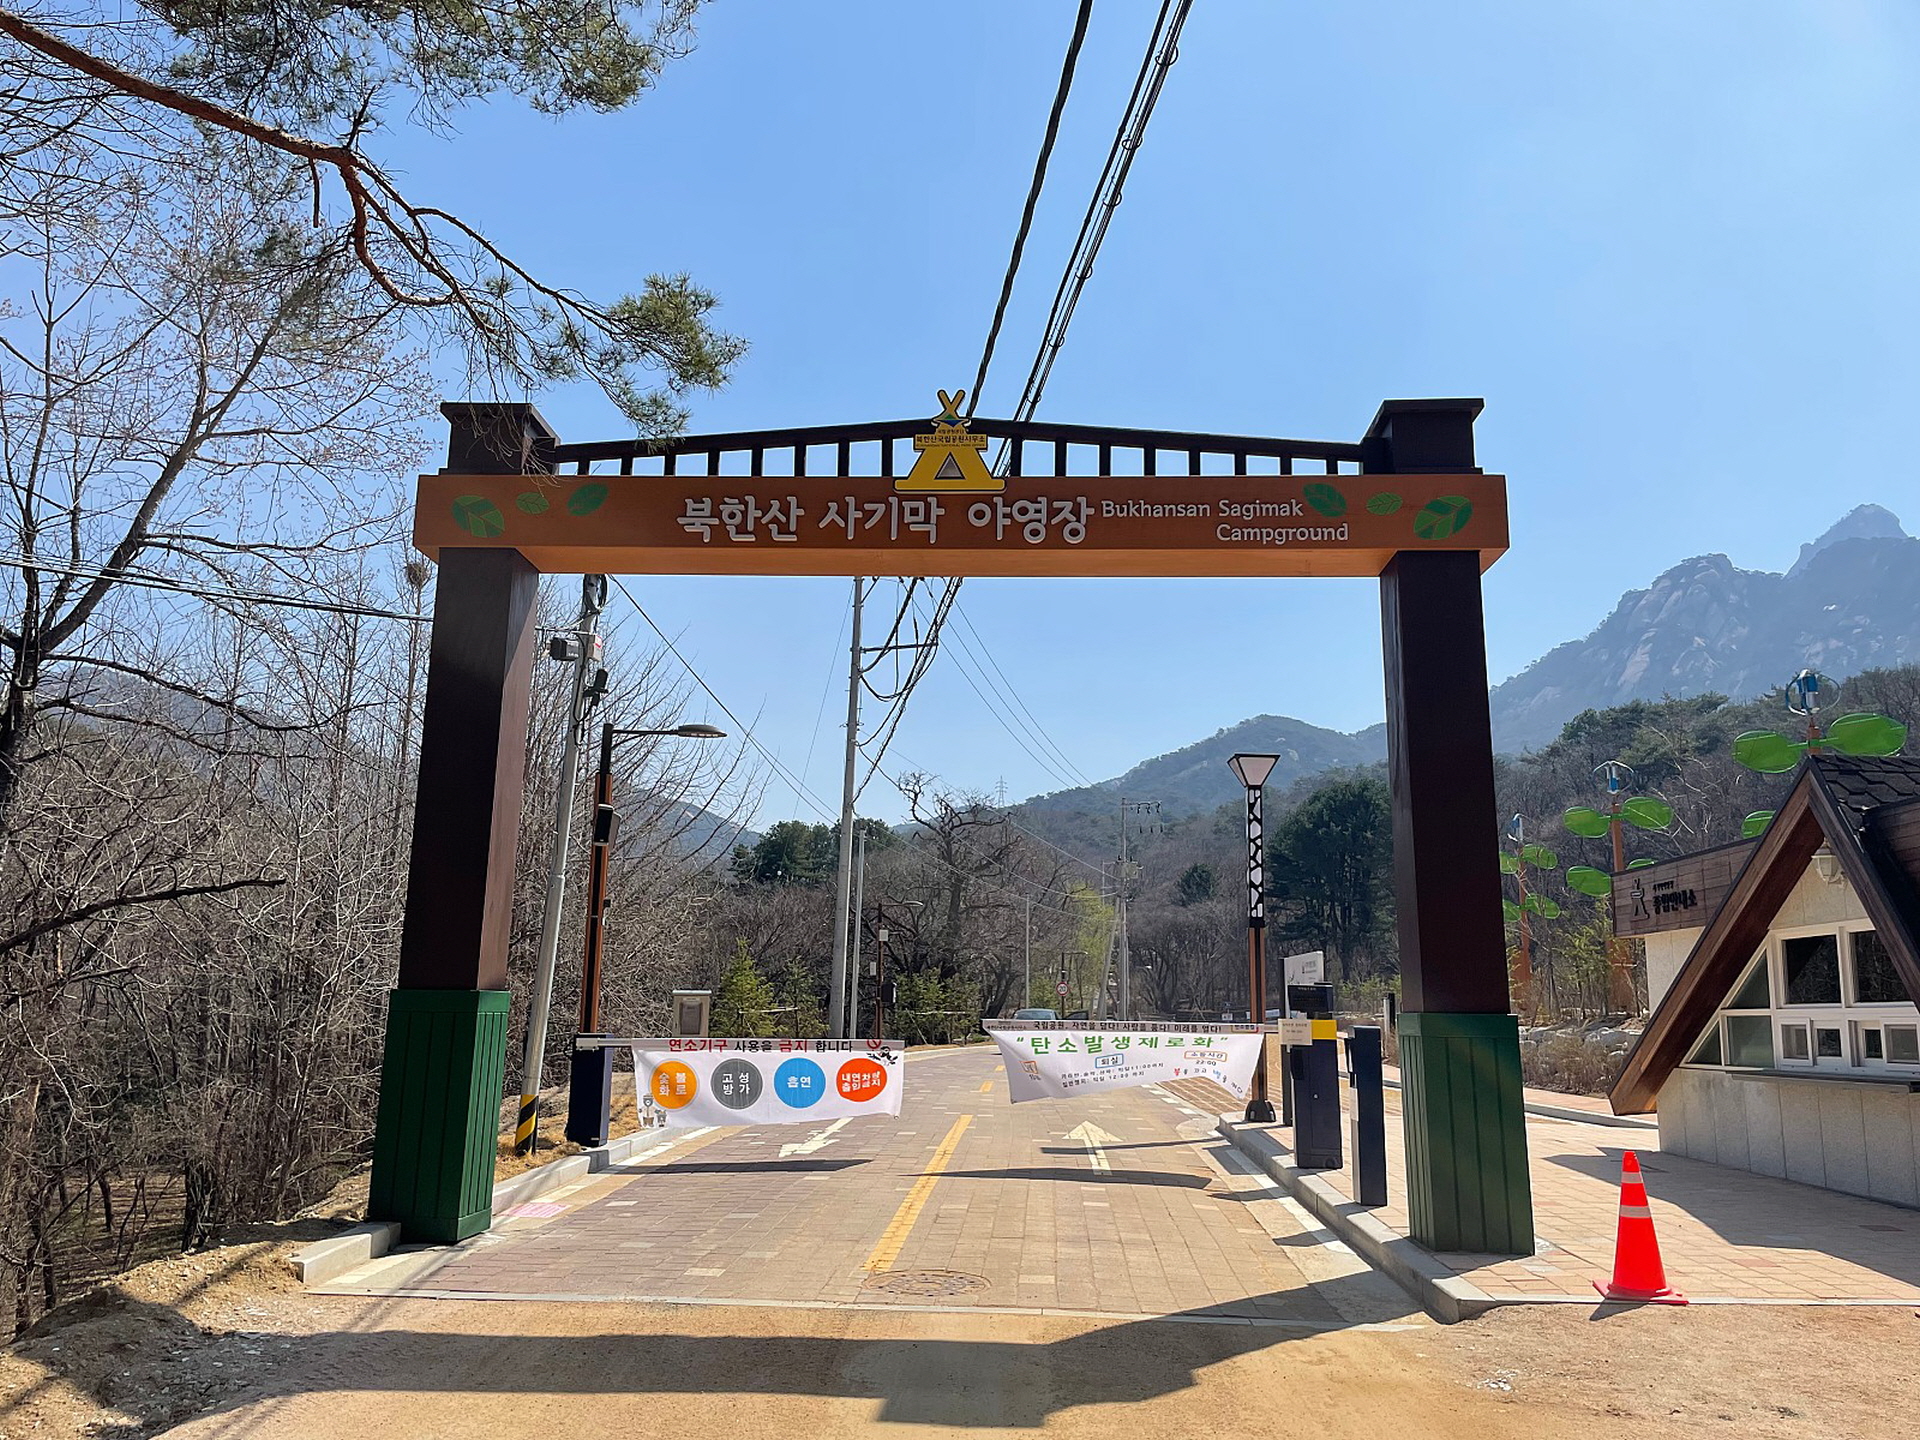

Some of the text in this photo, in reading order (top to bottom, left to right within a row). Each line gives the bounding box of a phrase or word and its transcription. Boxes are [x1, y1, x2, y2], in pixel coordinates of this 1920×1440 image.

[677, 495, 1095, 545] 북한산 사기막 야영장
[1101, 499, 1303, 520] Bukhansan Sagimak
[1216, 523, 1349, 545] Campground
[669, 1039, 853, 1053] 연소기구 사용을 금지 합니다
[787, 1076, 811, 1089] 흡연
